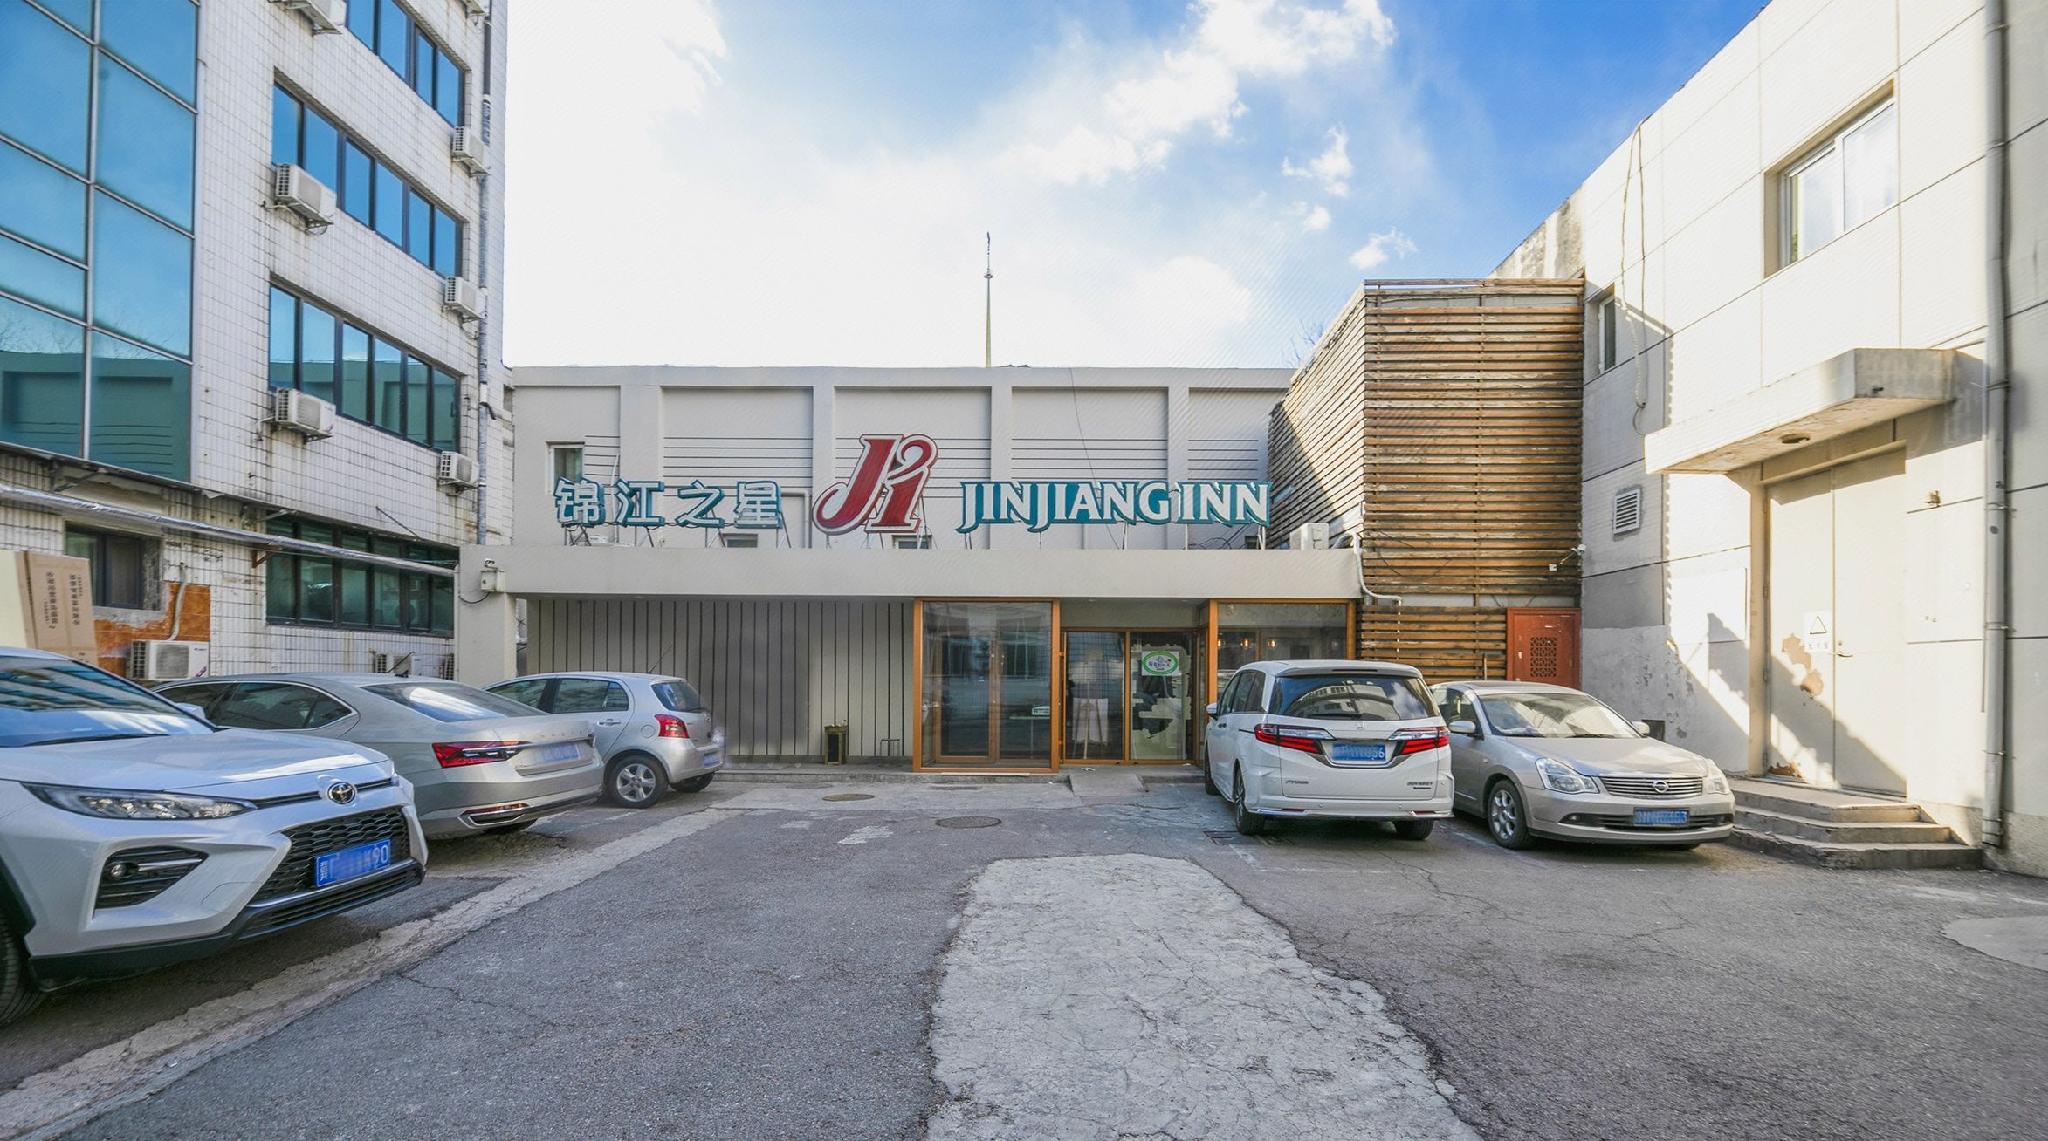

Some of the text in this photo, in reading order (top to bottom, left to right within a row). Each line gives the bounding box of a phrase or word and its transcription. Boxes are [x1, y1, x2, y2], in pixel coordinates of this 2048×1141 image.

[553, 476, 782, 529] 锦江之星
[956, 481, 1273, 533] JINJIANG INN
